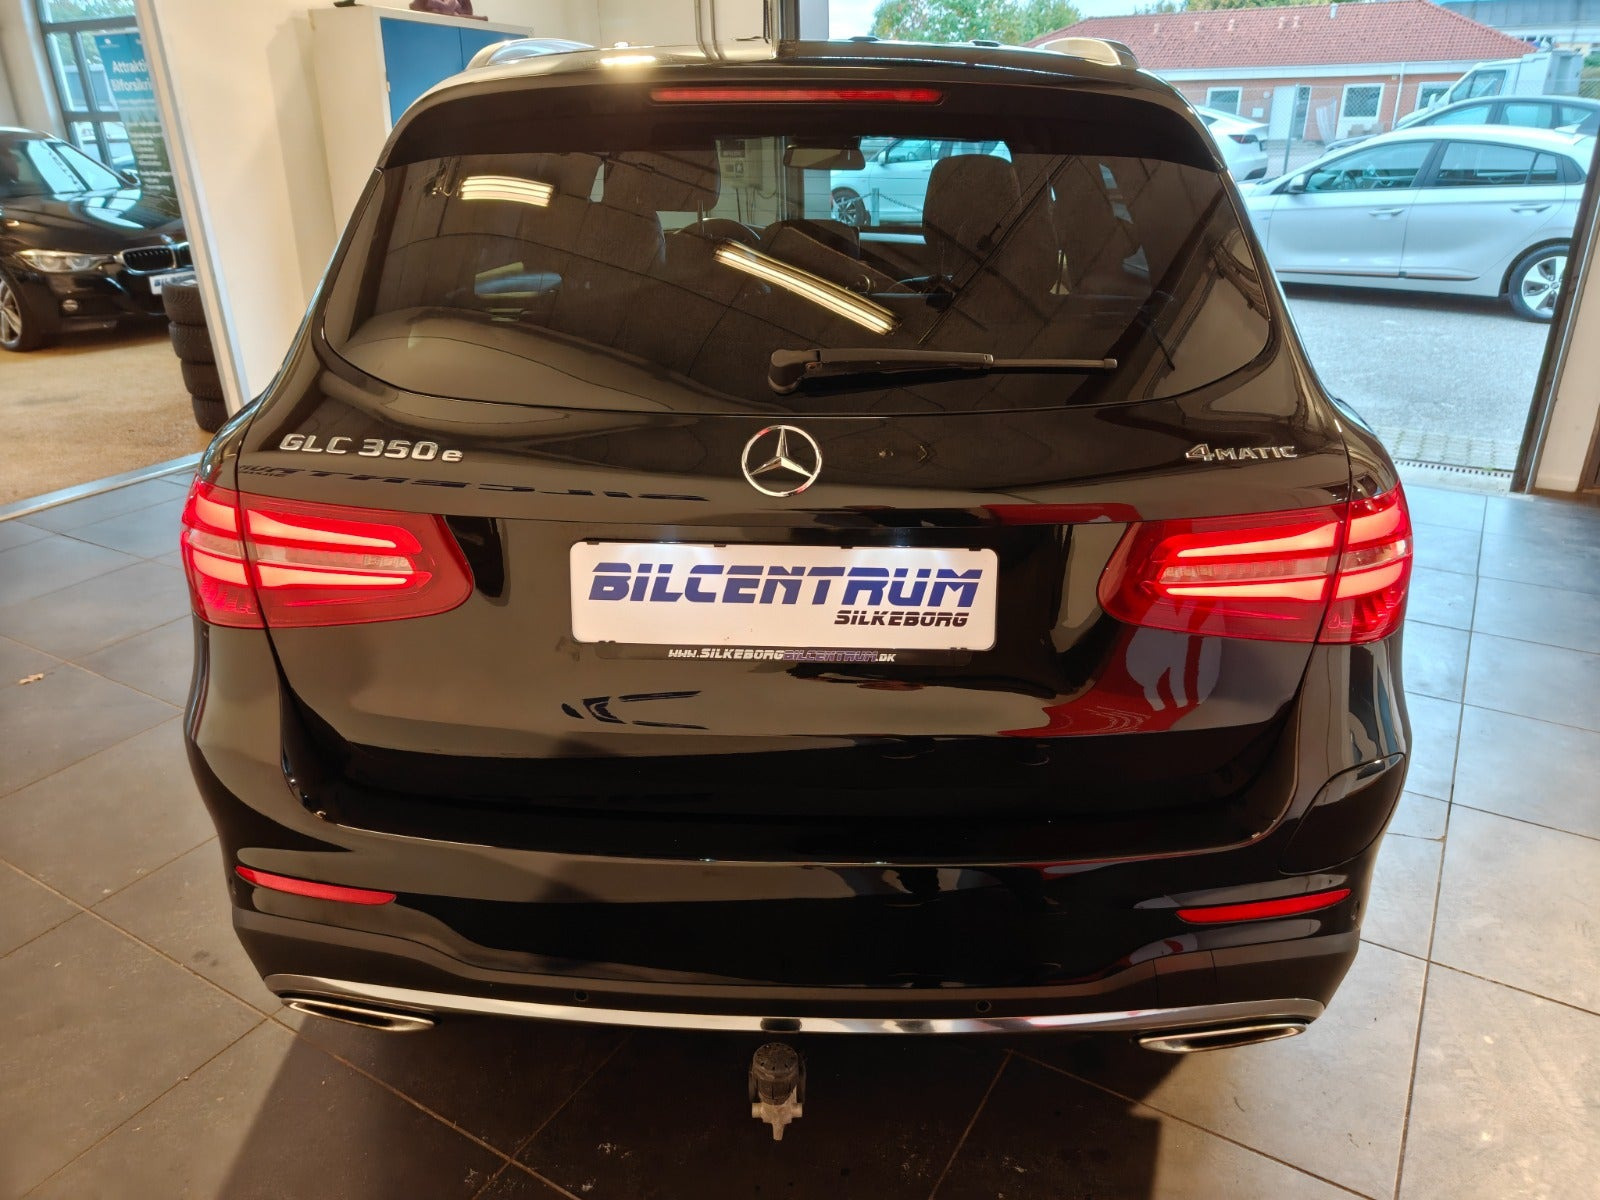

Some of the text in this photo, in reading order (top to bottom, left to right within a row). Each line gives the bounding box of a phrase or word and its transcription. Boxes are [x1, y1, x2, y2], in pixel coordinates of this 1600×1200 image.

[279, 433, 352, 454] GLC
[1185, 443, 1298, 461] 4MATIC
[588, 562, 983, 607] BILCENTRUM
[834, 609, 969, 627] SILKEBORG
